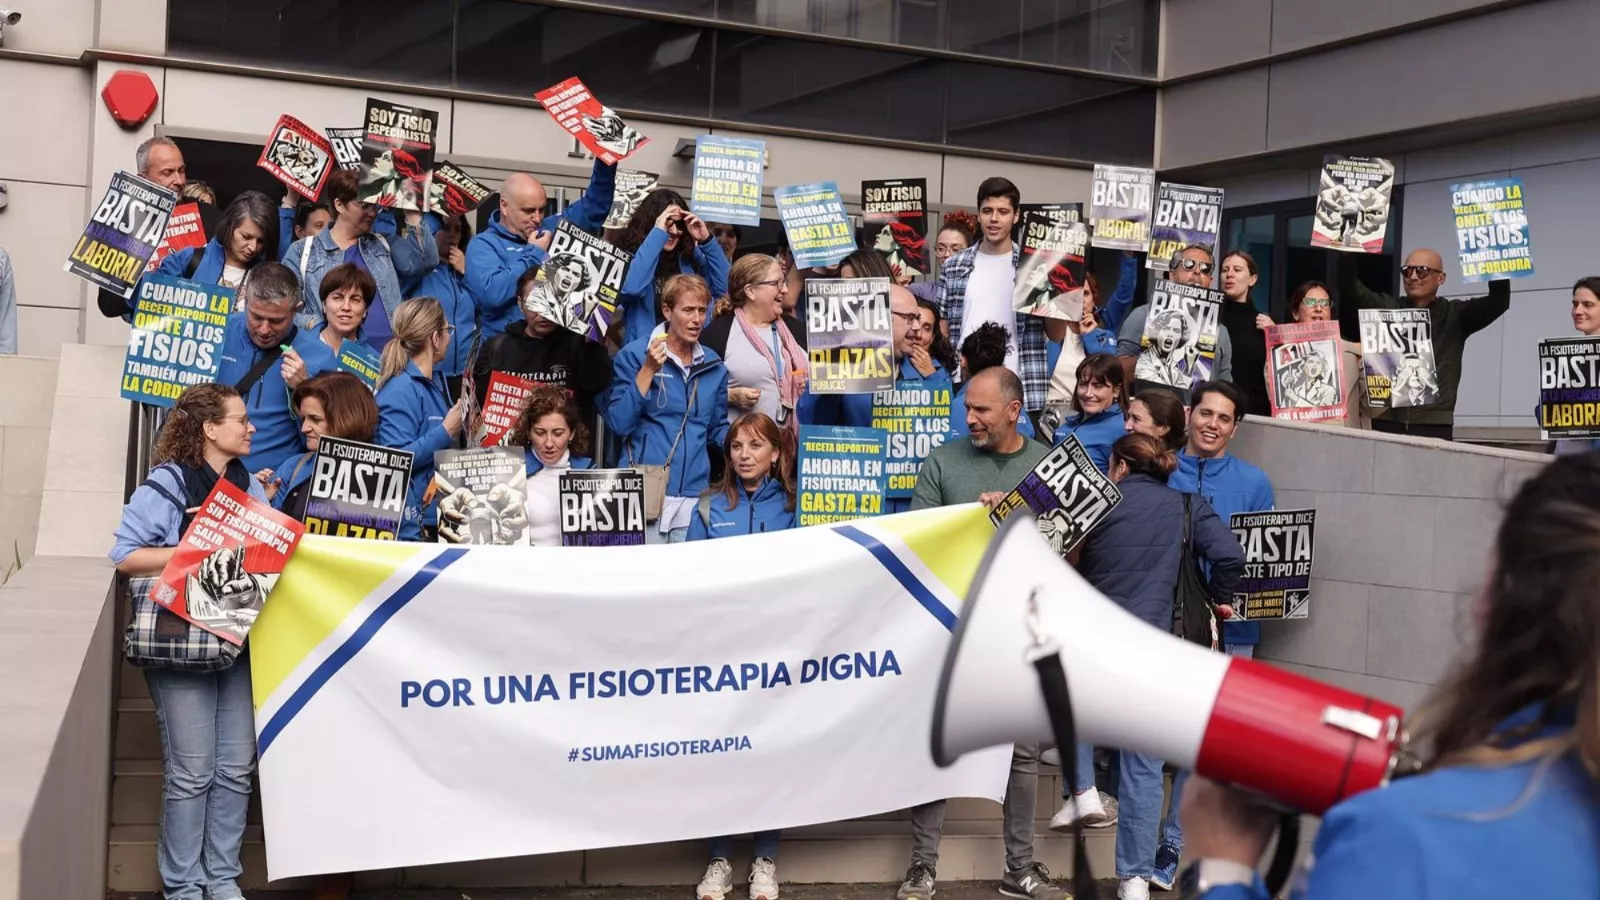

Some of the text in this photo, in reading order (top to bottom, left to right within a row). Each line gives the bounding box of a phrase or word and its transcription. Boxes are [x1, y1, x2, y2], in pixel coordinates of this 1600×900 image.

[370, 108, 432, 133] SOY FISIO
[368, 123, 430, 143] ESPECIALISTA
[698, 157, 760, 173] AHORRA EN
[440, 165, 490, 197] SOY FISIO
[696, 178, 758, 198] GASTA EN
[112, 176, 174, 212] LA FISIOTERAPIA DICE
[866, 186, 921, 201] SOY FISIO
[1093, 181, 1150, 210] BASTA
[1161, 190, 1222, 204] LA FISIOTERAPIA DICE
[1453, 185, 1521, 205] CUANDO LA
[782, 202, 842, 220] AHORRA EN
[866, 201, 922, 212] ESPECIALISTA
[1454, 200, 1523, 214] RECETA DEPORTIVA
[93, 189, 168, 246] BASTA
[169, 212, 196, 226] ORTIVA
[1156, 201, 1218, 233] BASTA
[1456, 210, 1524, 228] OMITE A LOS
[789, 223, 849, 242] GASTA EN
[1029, 222, 1088, 245] SOY FISIO
[1092, 219, 1148, 241] LABORAL
[1458, 224, 1528, 250] FISIOS,
[559, 220, 630, 262] LA FISIOTERAPIA DICE
[1026, 237, 1085, 256] ESPECIALISTA
[72, 236, 142, 284] LABORAL
[548, 230, 625, 293] BASTA
[1502, 247, 1530, 260] OMITE
[1463, 258, 1531, 276] LA CORDURA
[141, 282, 229, 314] CUANDO LA
[808, 283, 888, 294] LA FISIOTERAPIA DICE
[1155, 280, 1224, 303] LA FISIOTERAPIA DICE
[138, 300, 226, 327] RECETA DEPORTIVA
[809, 295, 889, 332] BASTA
[1150, 291, 1219, 344] BASTA
[1413, 312, 1428, 320] DICE
[135, 313, 224, 344] OMITE A LOS
[1362, 322, 1430, 353] BASTA
[130, 328, 217, 373] FISIOS,
[1540, 346, 1548, 356] LA
[1551, 343, 1593, 356] FISIOTERAPIA
[128, 361, 177, 382] TAMBIÉN
[811, 348, 891, 380] PLAZAS
[1541, 355, 1600, 389] BAST
[123, 375, 188, 399] LA CORD
[493, 382, 521, 395] RECETA
[490, 392, 504, 404] SIN
[874, 390, 949, 405] CUANDO LA
[485, 413, 510, 427] SALIR
[873, 407, 949, 416] RECETA DEPORTIVA
[872, 418, 949, 432] OMITE A LOS
[320, 441, 410, 469] LA FISIOTERAPIA DICE
[803, 442, 883, 454] "RECETA DEPORTIVA"
[448, 470, 466, 478] PERO
[468, 468, 476, 476] EN
[802, 459, 882, 476] AHORRA EN
[886, 462, 916, 474] MBIÉN
[1063, 437, 1120, 505] LA FISIOTERAPIA DICE
[312, 456, 404, 512] BASTA
[465, 475, 497, 485] SON DOS
[561, 479, 642, 491] LA FISIOTERAPIA DICE
[802, 478, 880, 492] FISIOTERAPIA,
[1035, 446, 1108, 532] BASTA
[562, 493, 643, 532] BASTA
[801, 493, 881, 513] GASTA EN
[214, 491, 246, 516] RECETA
[246, 510, 295, 543] DEPORTIVA
[1232, 513, 1313, 528] LA FISIOTERAPIA DICE
[194, 524, 224, 546] SALIR
[206, 503, 225, 520] SIN
[224, 512, 289, 555] FISIOTERAPIA
[188, 535, 211, 550] MAL?
[1269, 562, 1310, 577] TIPO DE
[1248, 599, 1283, 608] DEBE HABER
[1248, 609, 1282, 617] FISIOTERAPIA
[400, 649, 901, 708] POR UNA FISIOTERAPIA DIGNA
[569, 736, 752, 763] #SUMAFISIOTERAPIA
